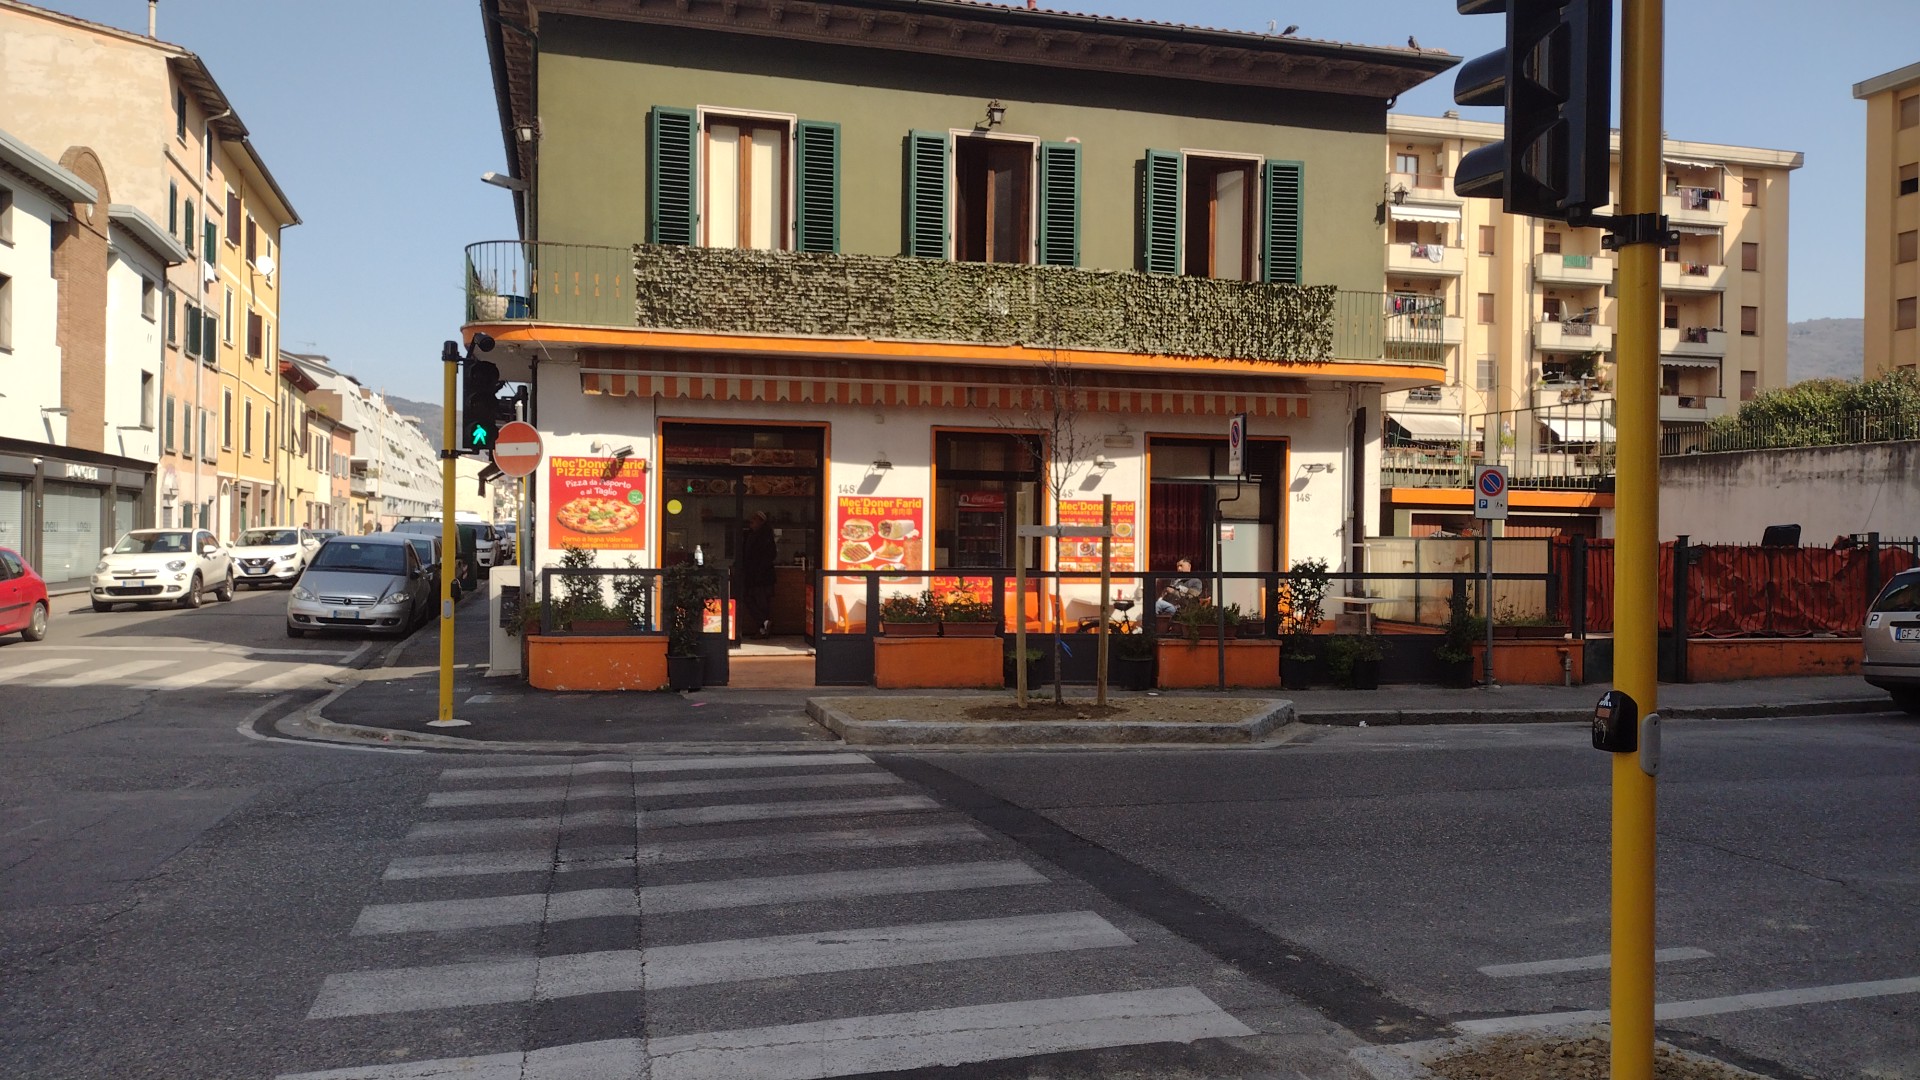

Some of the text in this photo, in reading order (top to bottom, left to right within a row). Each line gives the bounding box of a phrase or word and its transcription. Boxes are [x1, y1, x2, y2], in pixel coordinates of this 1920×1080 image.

[552, 458, 645, 469] Mec'Doner Farid
[556, 468, 611, 477] PIZZERIA
[565, 480, 587, 488] Pizza
[594, 487, 617, 496] Taglio
[840, 498, 922, 508] Mec'Doner Farid
[1059, 501, 1134, 511] Mec'Done Farid
[848, 507, 885, 515] KEBAB
[1869, 614, 1879, 626] P
[1901, 629, 1912, 638] GF
